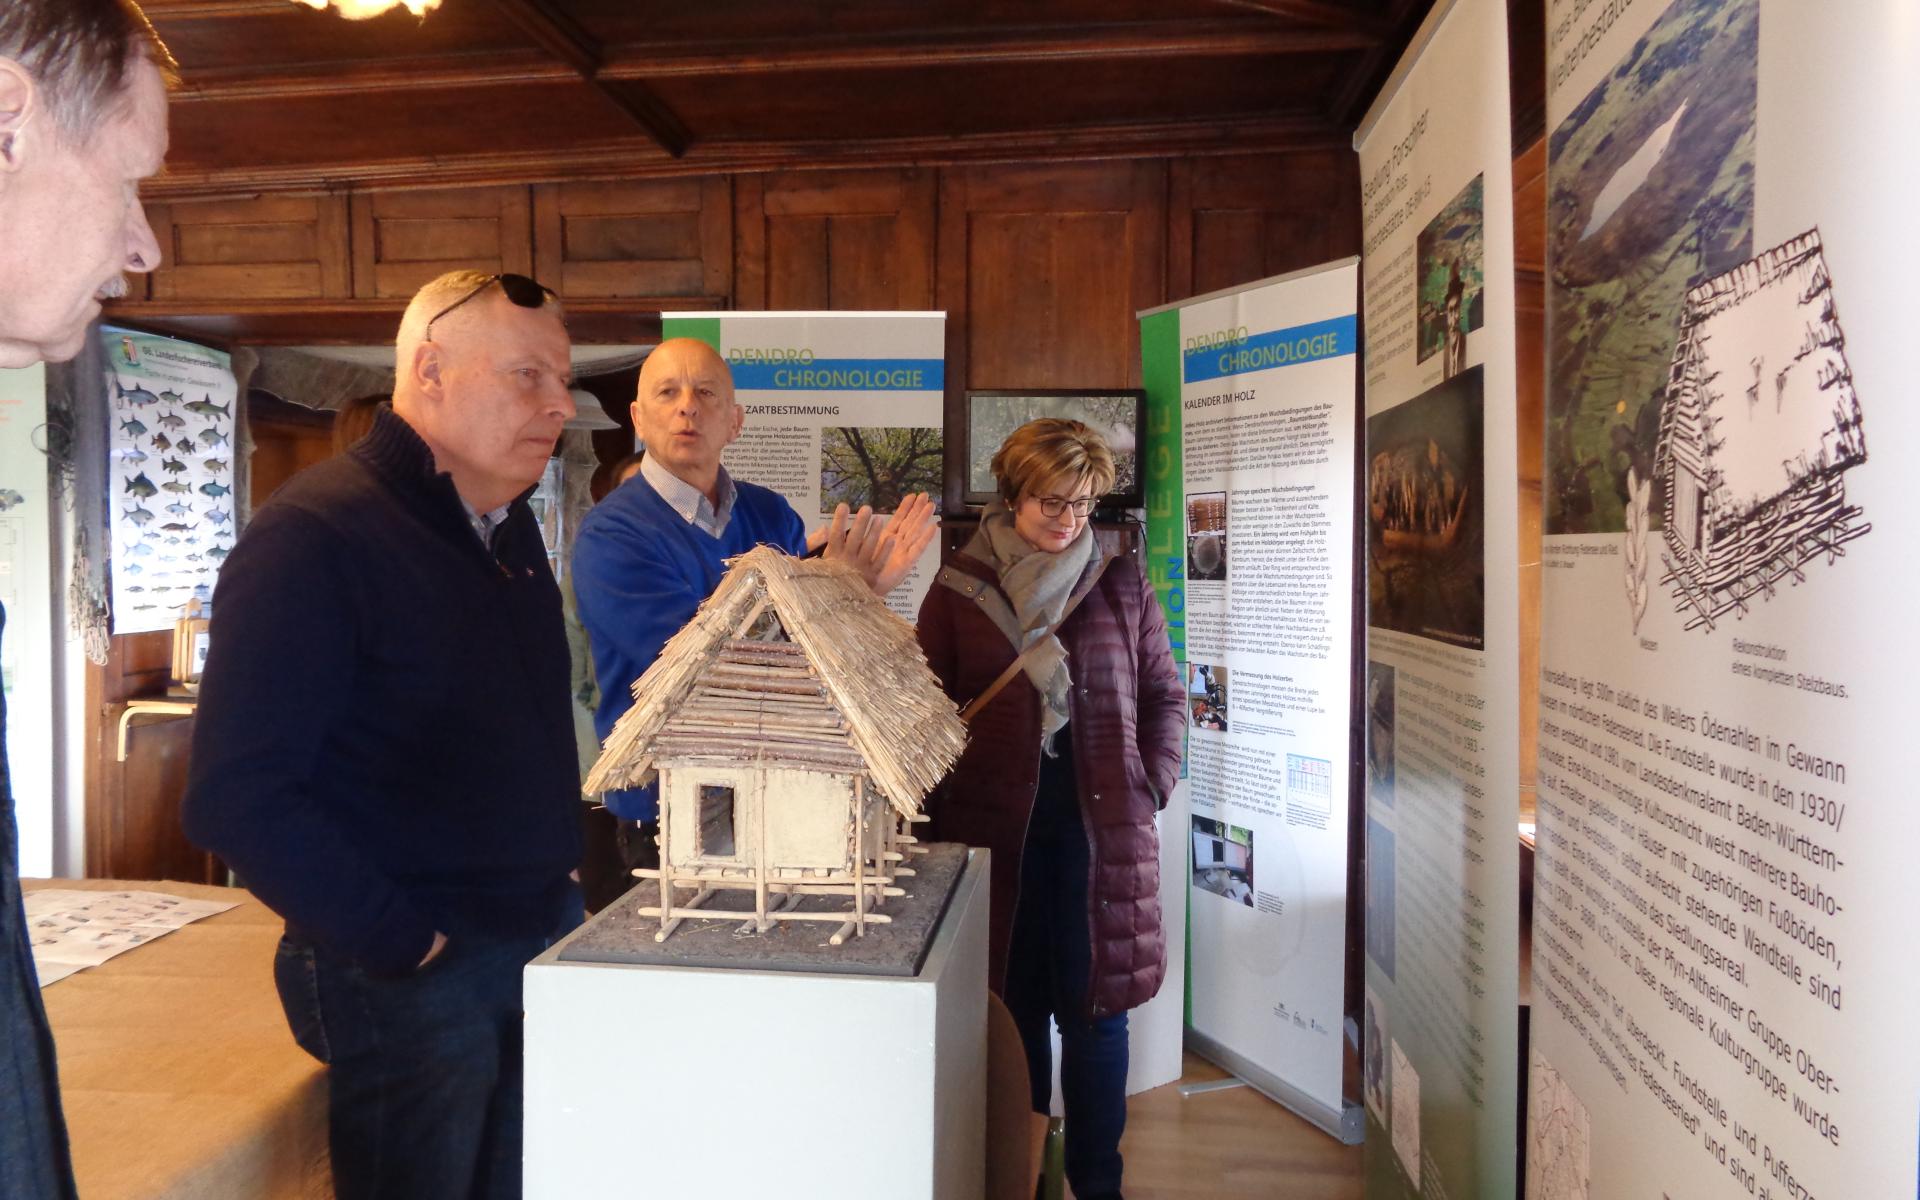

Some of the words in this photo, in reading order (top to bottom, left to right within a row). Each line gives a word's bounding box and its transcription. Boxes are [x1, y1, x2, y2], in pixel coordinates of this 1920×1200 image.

[729, 348, 814, 365] DENDRO
[774, 370, 922, 387] CHRONOLOGIE
[1186, 326, 1248, 357] DENDRO
[1218, 333, 1337, 373] CHRONOLOGIE
[744, 405, 840, 415] ZARTBESTIMMUNG
[1184, 396, 1221, 410] KALENDER
[1222, 394, 1233, 404] IM
[1234, 390, 1256, 401] HOLZ
[1732, 661, 1752, 677] eines
[1753, 664, 1795, 686] kompletten
[1796, 673, 1849, 699] Stelzbaus.
[1597, 682, 1614, 701] 500m
[1643, 698, 1659, 720] des
[1662, 703, 1696, 733] Weilers
[1701, 711, 1761, 754] Ödenahlen
[1766, 735, 1780, 761] im
[1786, 743, 1846, 785] Gewann
[1590, 739, 1602, 758] und
[1639, 761, 1732, 822] Landesdenkmalamt
[1736, 804, 1844, 872] Baden-Württem-
[1648, 732, 1662, 755] Die
[1664, 739, 1716, 776] Fundstelle
[1719, 763, 1755, 792] wurde
[1759, 773, 1768, 798] in
[1772, 779, 1794, 810] den
[1800, 790, 1846, 833] 1930/
[1638, 825, 1667, 860] Häuser
[1671, 851, 1687, 874] mit
[1692, 862, 1763, 918] zugehörigen
[1769, 900, 1843, 971] Fußböden,
[1644, 797, 1703, 846] Kulturschicht
[1705, 831, 1735, 863] weist
[1738, 848, 1788, 890] mehrere
[1791, 872, 1843, 916] Bauho-
[1645, 867, 1682, 906] aufrecht
[1686, 894, 1737, 940] stehende
[1744, 924, 1802, 985] Wandteile
[1809, 974, 1842, 1011] sind
[1650, 901, 1664, 928] das
[1666, 913, 1749, 989] Siedlungsareal.
[1634, 955, 1657, 991] Diese
[1659, 982, 1705, 1032] regionale
[1708, 1017, 1788, 1102] Kulturgruppe
[1792, 1091, 1840, 1148] wurde
[1648, 936, 1662, 958] der
[1664, 947, 1744, 1023] Pfyn-Altheimer
[1747, 1009, 1792, 1064] Gruppe
[1796, 1048, 1840, 1094] Ober-
[1626, 1012, 1668, 1071] überdeckt.
[1673, 1060, 1728, 1128] Fundstelle
[1734, 1120, 1757, 1156] und
[1763, 1145, 1816, 1200] Pufferz
[1704, 1131, 1727, 1166] und
[1730, 1157, 1755, 1196] sind
